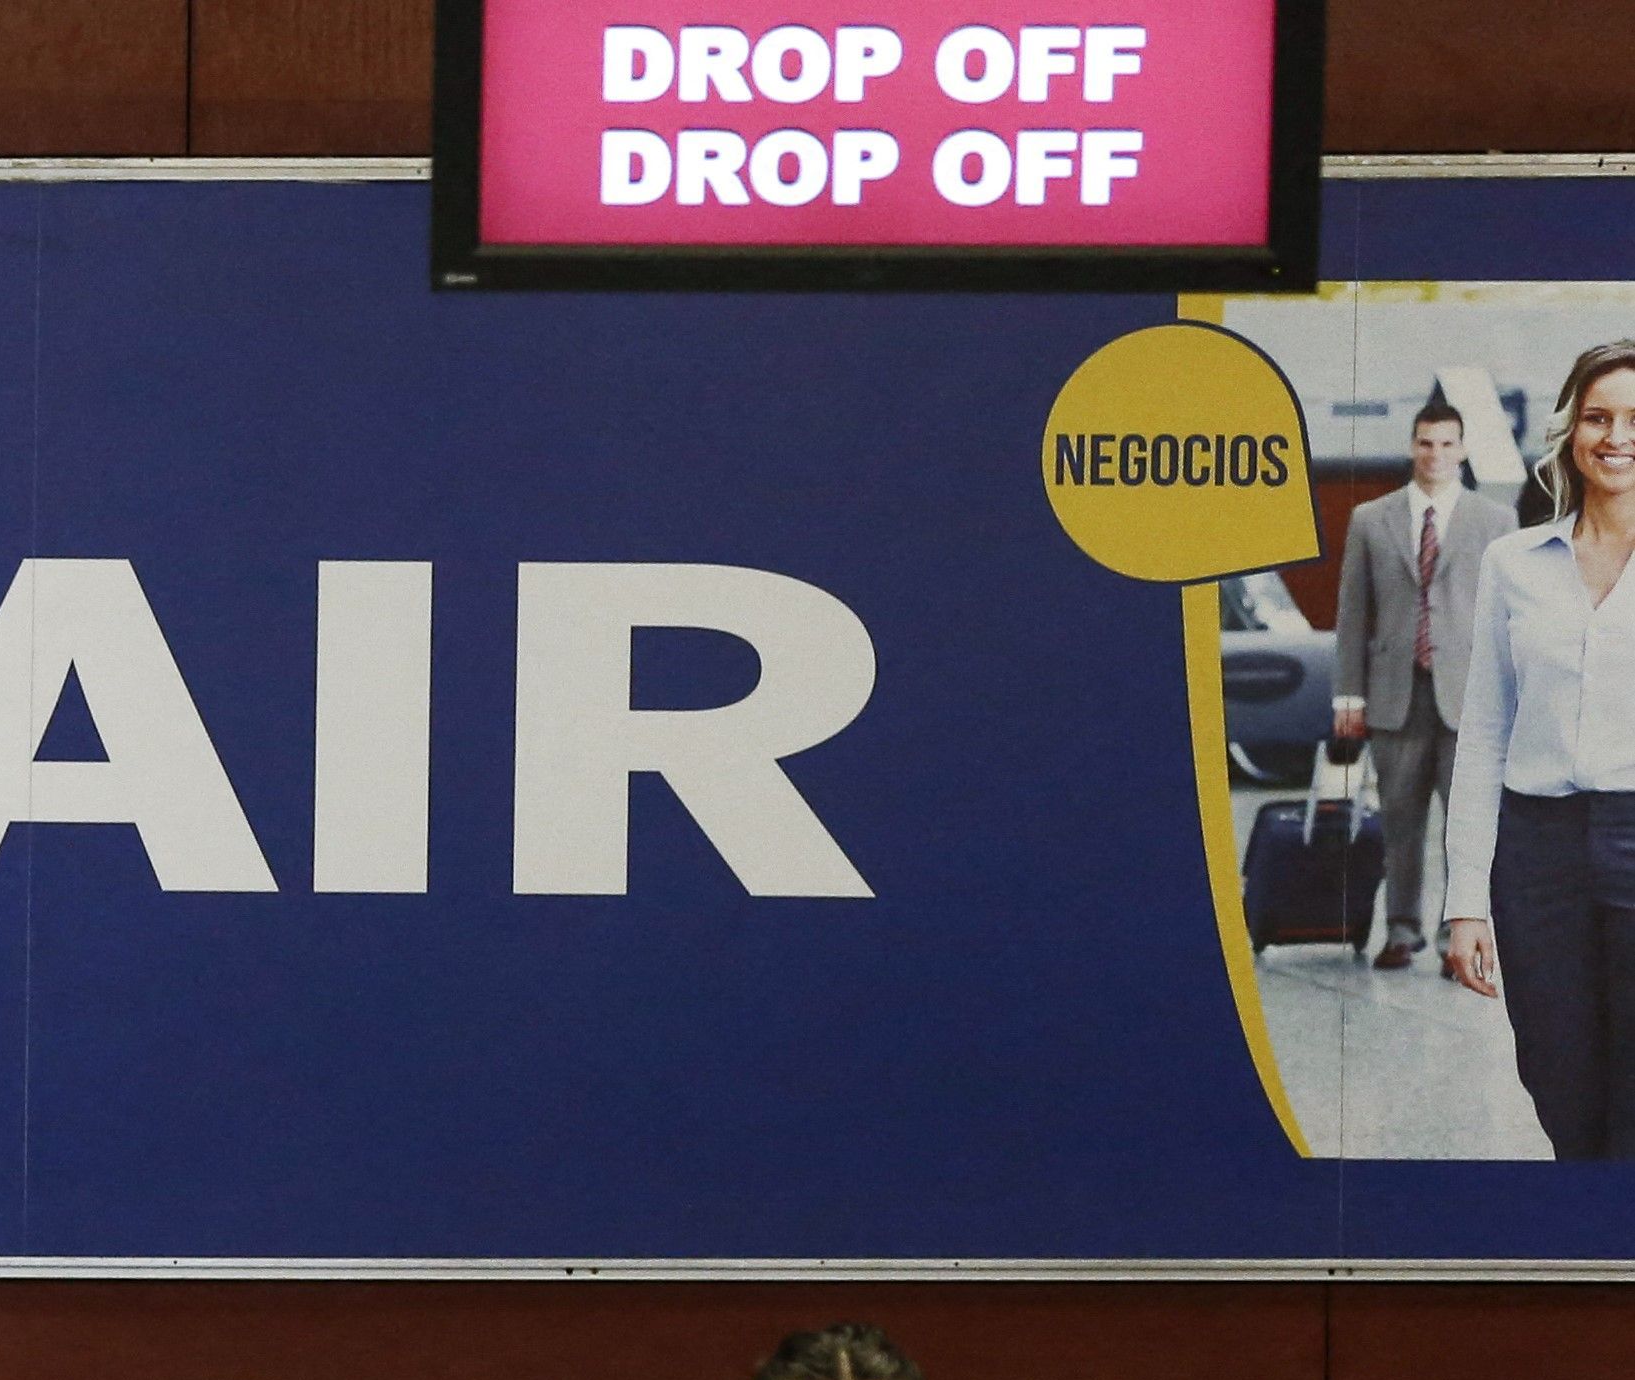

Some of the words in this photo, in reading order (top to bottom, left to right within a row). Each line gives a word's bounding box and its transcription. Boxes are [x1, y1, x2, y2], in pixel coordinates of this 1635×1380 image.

[602, 26, 902, 103] DROP
[935, 26, 1146, 103] OFF
[600, 130, 899, 206] DROP
[933, 130, 1143, 206] OFF
[1054, 432, 1290, 488] NEGOCIOS
